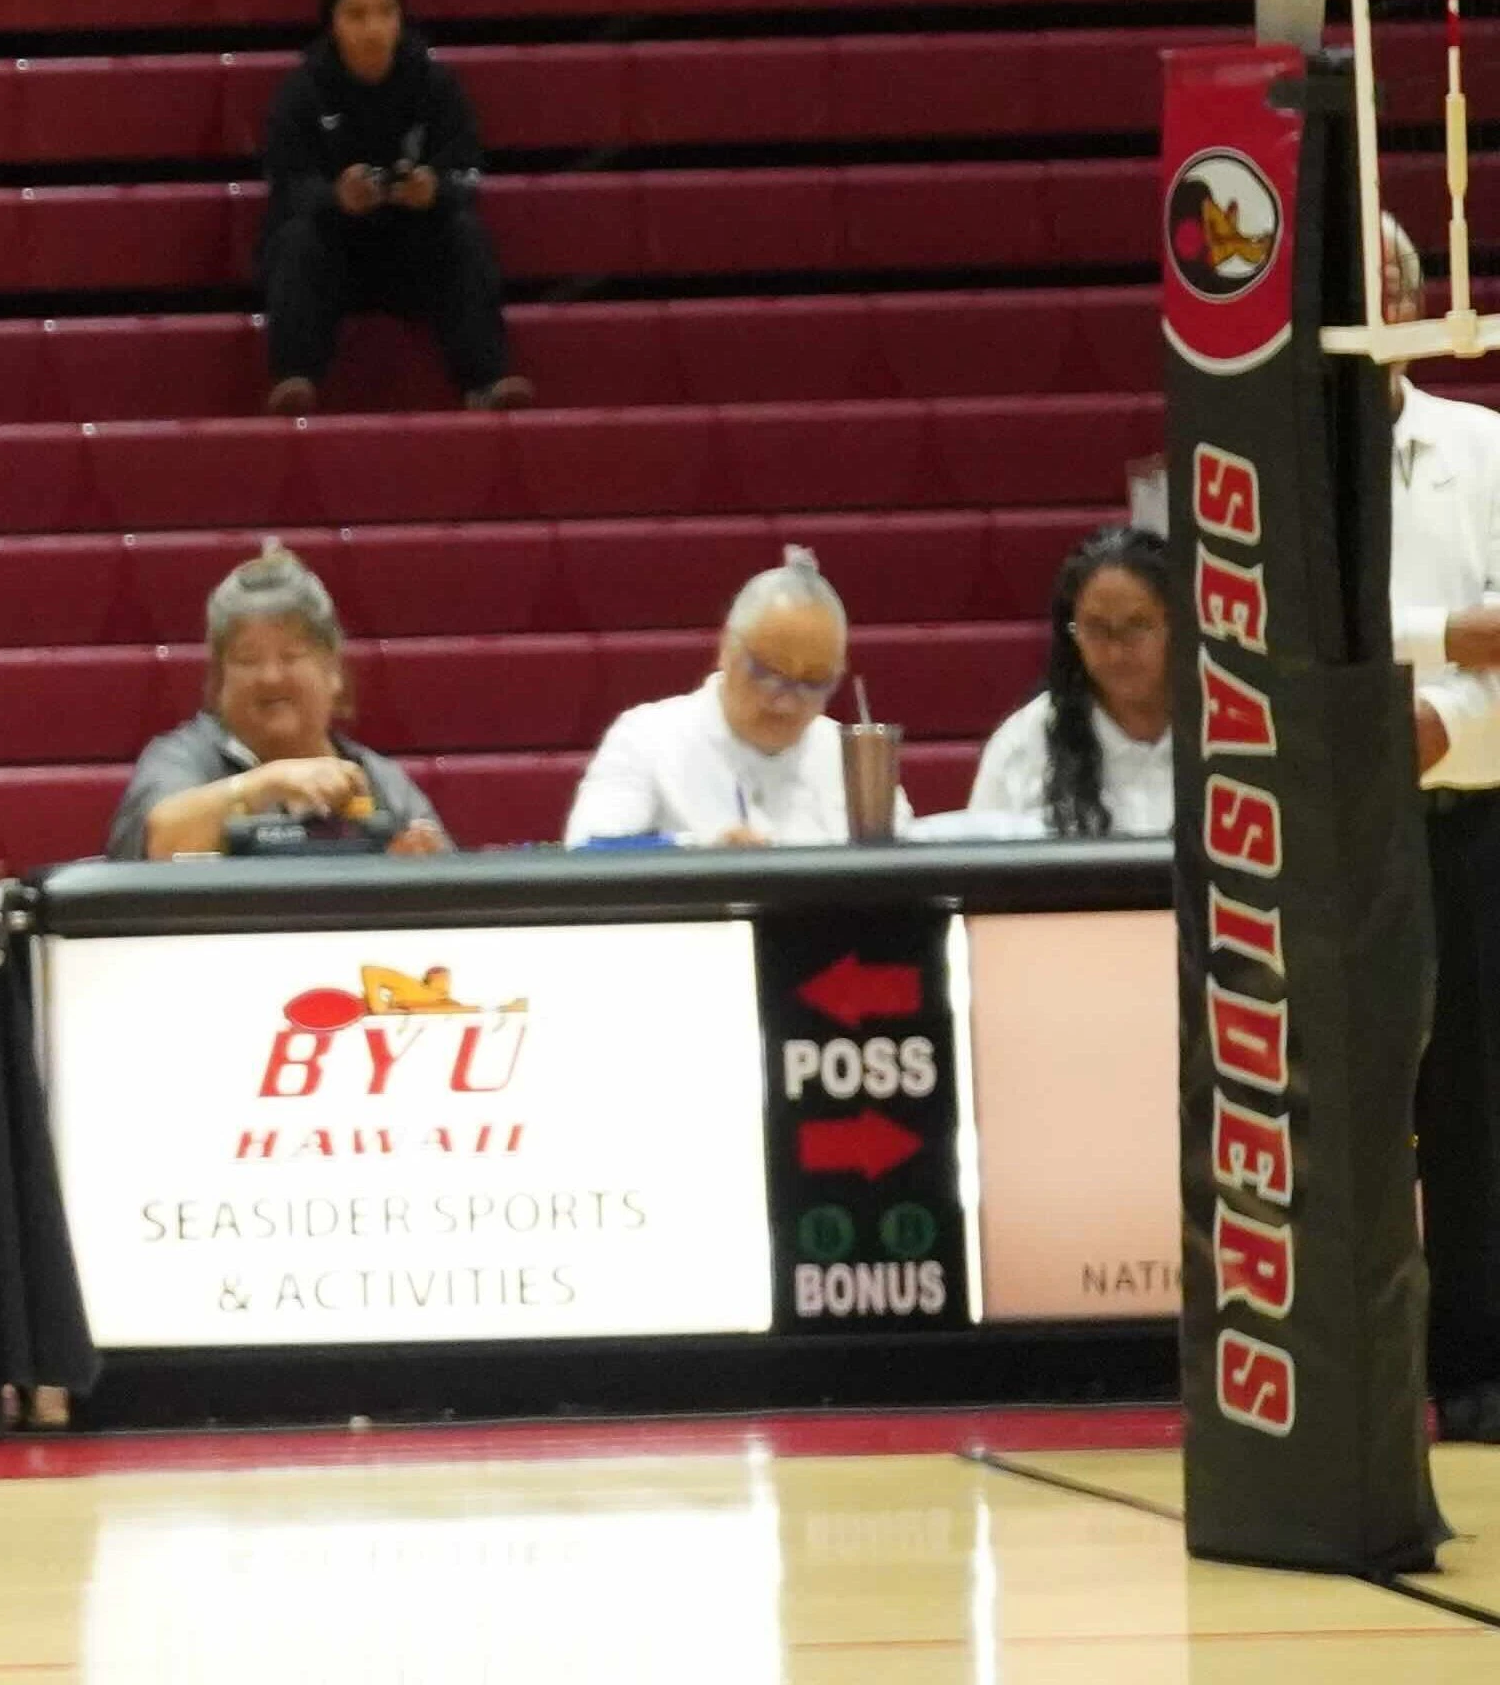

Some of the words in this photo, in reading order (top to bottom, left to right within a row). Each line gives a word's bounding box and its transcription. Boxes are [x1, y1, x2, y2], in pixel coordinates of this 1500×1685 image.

[1192, 442, 1296, 1437] SEASIDERS
[258, 1023, 529, 1097] BYU
[783, 1036, 938, 1101] POSS
[235, 1122, 525, 1160] HAWAII
[140, 1195, 412, 1243] SEASIDER
[436, 1190, 648, 1234] SPORTS
[218, 1276, 251, 1313] &
[276, 1265, 578, 1311] ACTIVITIES
[795, 1259, 946, 1318] BONUS
